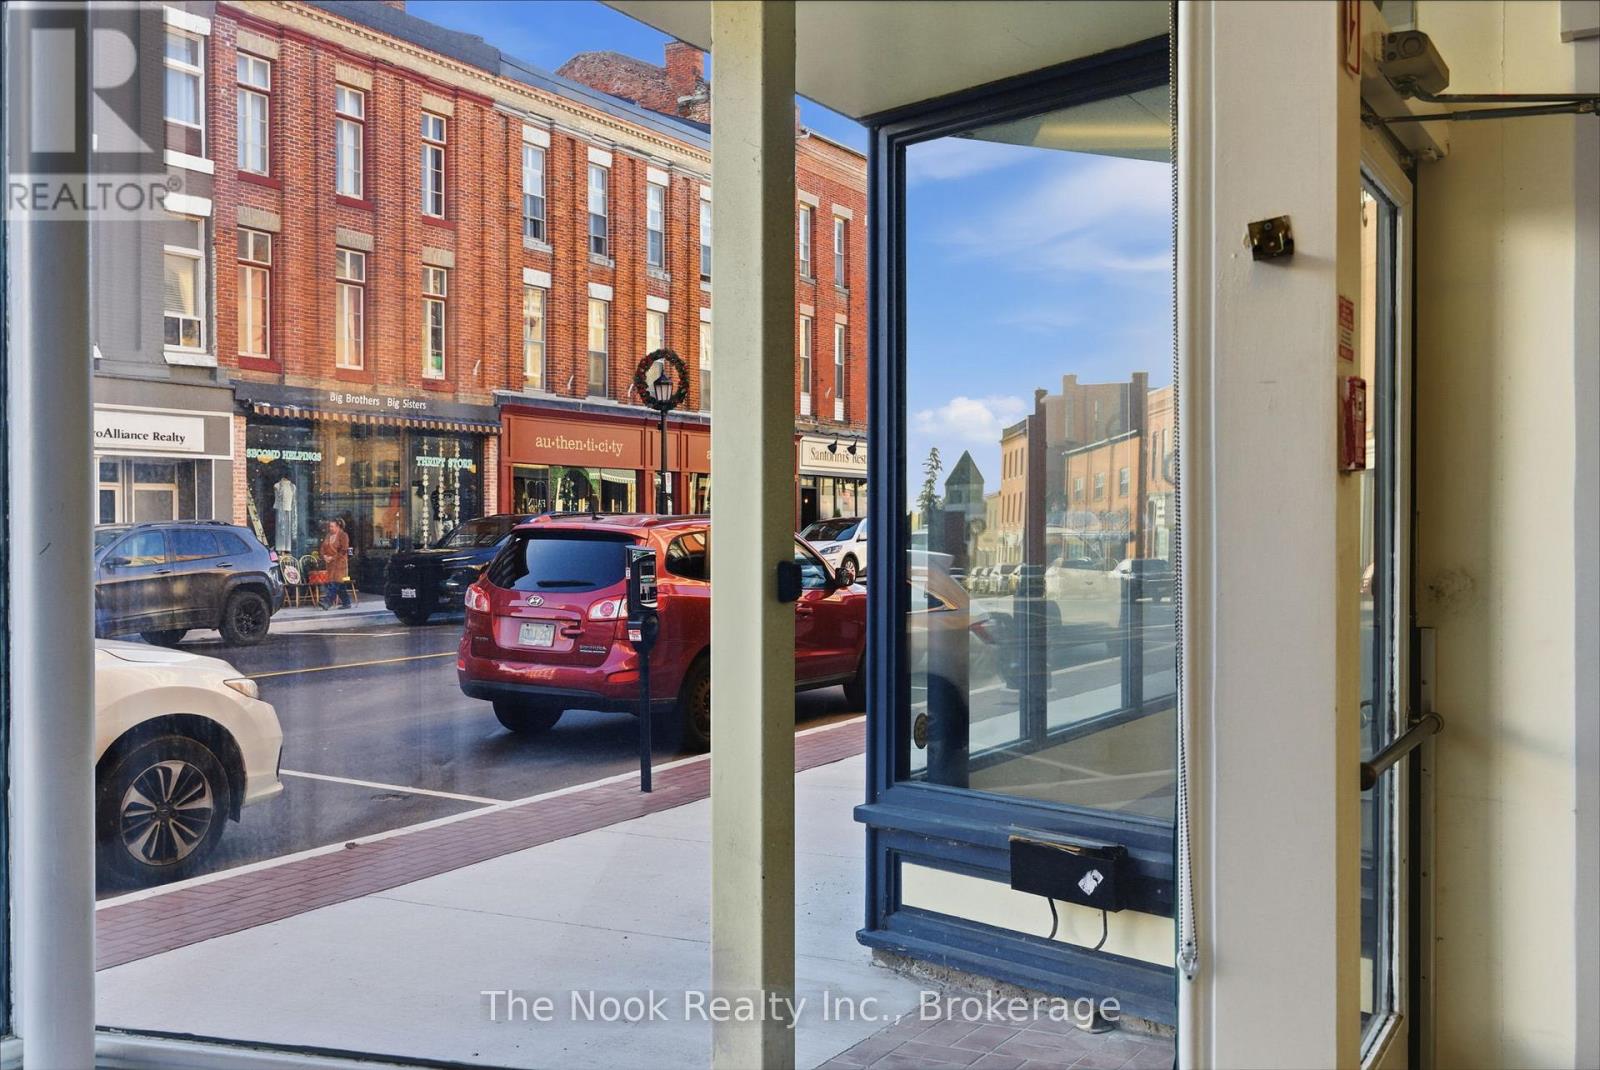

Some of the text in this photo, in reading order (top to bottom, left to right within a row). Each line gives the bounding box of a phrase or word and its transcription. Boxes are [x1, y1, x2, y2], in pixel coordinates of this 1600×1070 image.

[329, 391, 427, 410] Big Brothers Big Sisters
[94, 427, 185, 445] oAlliance Realty
[246, 448, 322, 461] SECOND HELPINGS
[415, 456, 446, 467] THRIFT
